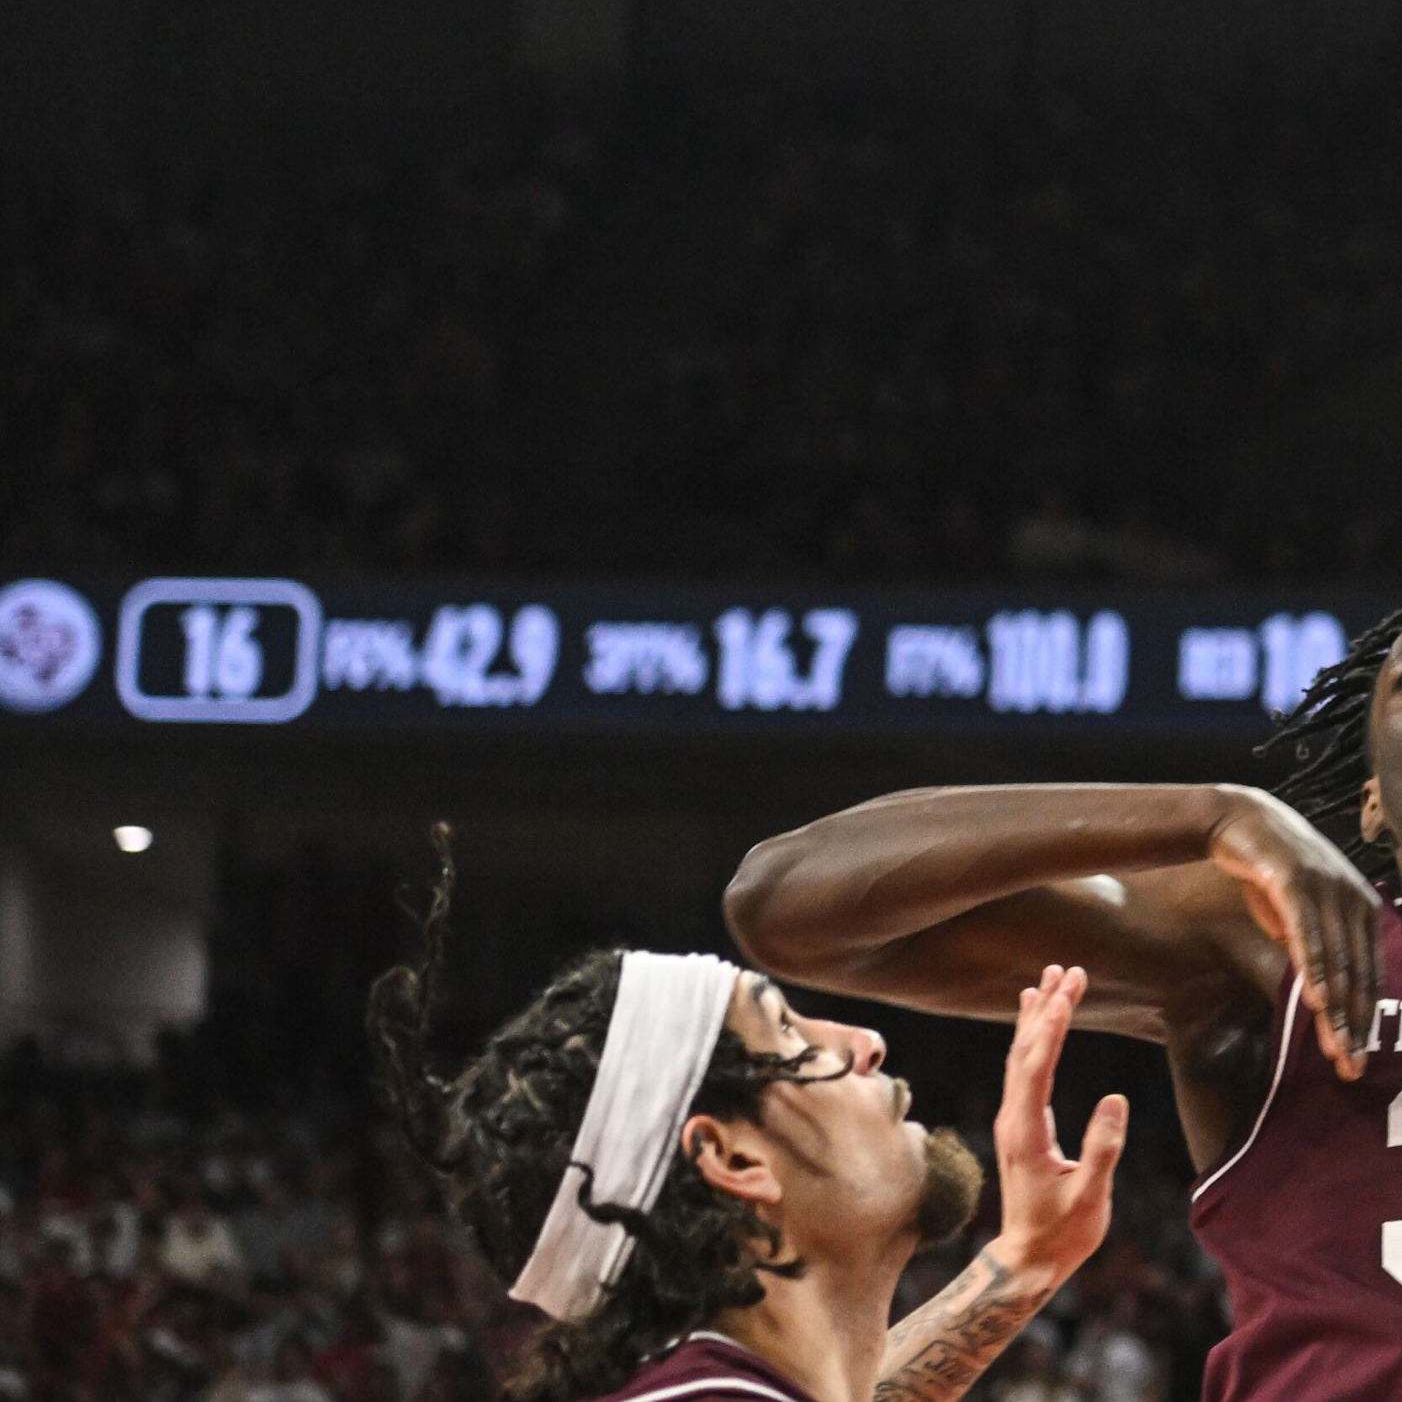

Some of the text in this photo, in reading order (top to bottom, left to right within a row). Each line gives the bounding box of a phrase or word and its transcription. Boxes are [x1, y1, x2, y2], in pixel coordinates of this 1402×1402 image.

[180, 603, 264, 699] 16
[426, 603, 560, 708] 42.9
[717, 609, 856, 709] 16.7
